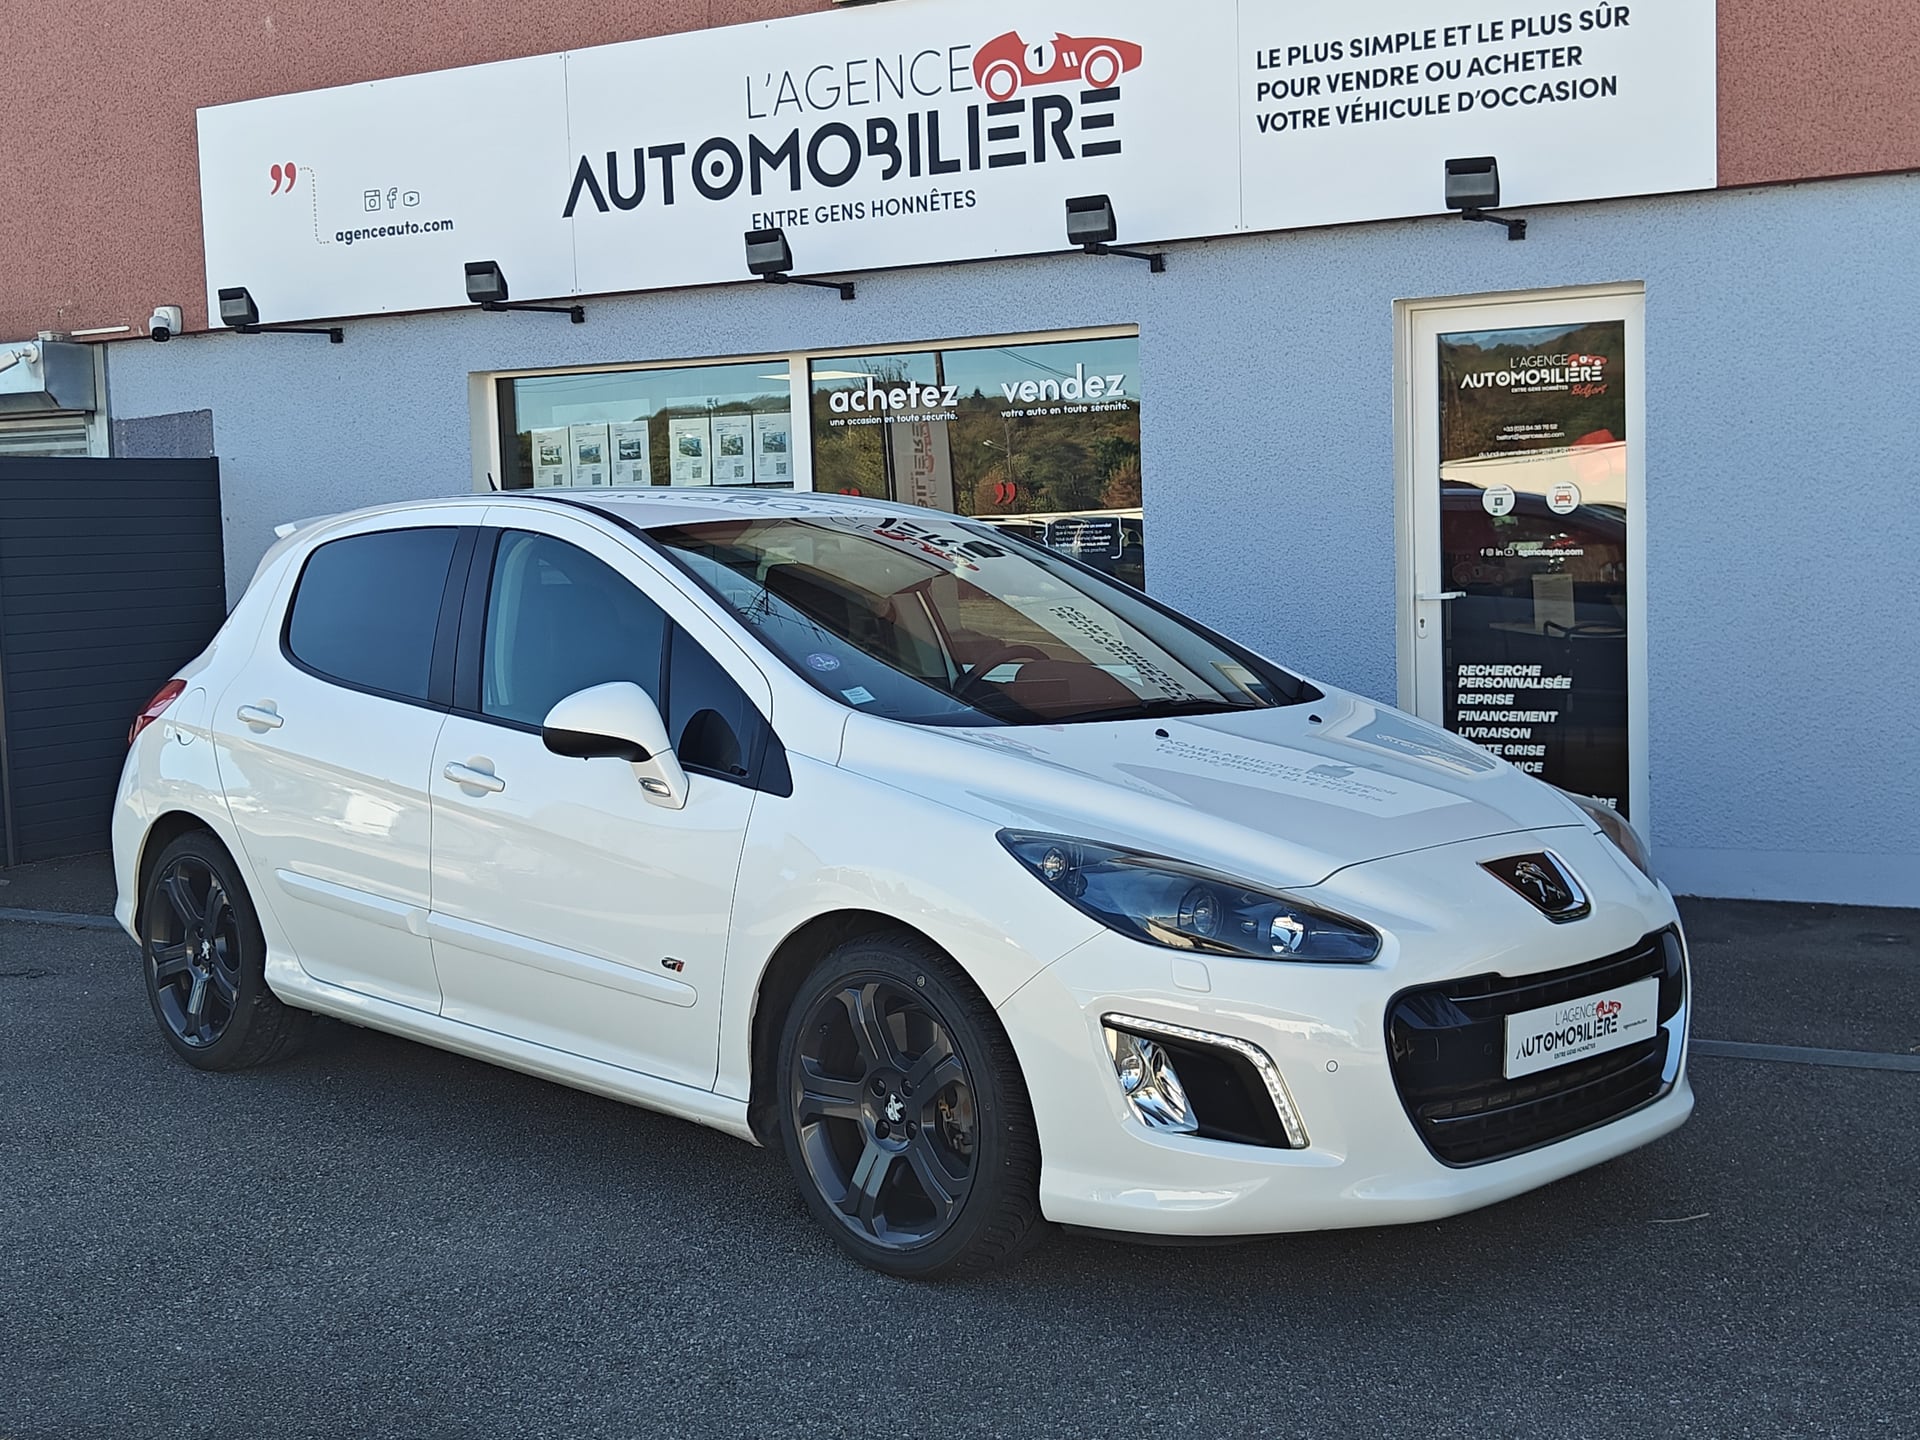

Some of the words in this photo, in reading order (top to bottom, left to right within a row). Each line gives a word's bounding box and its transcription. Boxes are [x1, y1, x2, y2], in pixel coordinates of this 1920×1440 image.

[1256, 49, 1281, 70] LE
[1288, 42, 1344, 66] PLUS
[1349, 30, 1437, 59] SIMPLE
[1443, 25, 1472, 47] ET
[1477, 21, 1504, 43] LE
[1511, 13, 1572, 40] PLUS
[1579, 2, 1630, 29] SÛR
[746, 44, 973, 119] L'AGENCE
[1257, 77, 1321, 102] POUR
[1326, 64, 1420, 93] VENDRE
[1424, 59, 1461, 82] OU
[1467, 45, 1583, 77] ACHETER
[1257, 109, 1330, 133] VOTRE
[1336, 96, 1451, 126] VÉHICULE
[1458, 75, 1617, 112] D'OCCASION
[752, 209, 810, 230] ENTRE
[815, 201, 865, 224] GENS
[872, 188, 977, 217] HONNÊTES
[335, 217, 454, 245] agenceauto.com
[1510, 354, 1568, 368] L'AGENCE
[1001, 363, 1126, 404] vendez
[829, 376, 959, 413] achetez
[1000, 410, 1024, 418] votre
[1026, 407, 1047, 416] auto
[1050, 407, 1061, 415] en
[1064, 405, 1088, 413] toute
[1091, 401, 1130, 412] sérénité.
[830, 419, 845, 427] une
[847, 415, 881, 425] occasion
[897, 414, 919, 422] toute
[922, 410, 958, 421] sécurité.
[1518, 548, 1584, 557] agenceauto.com
[1458, 665, 1542, 676] RECHERCHE
[1458, 675, 1572, 689] PERSONNALISÉE
[1457, 694, 1515, 705] REPRISE
[1457, 710, 1559, 722] FINANCEMENT
[1458, 727, 1532, 739] LIVRAISON
[1504, 744, 1546, 756] GRISE
[1555, 1002, 1597, 1026] L'AGENCE
